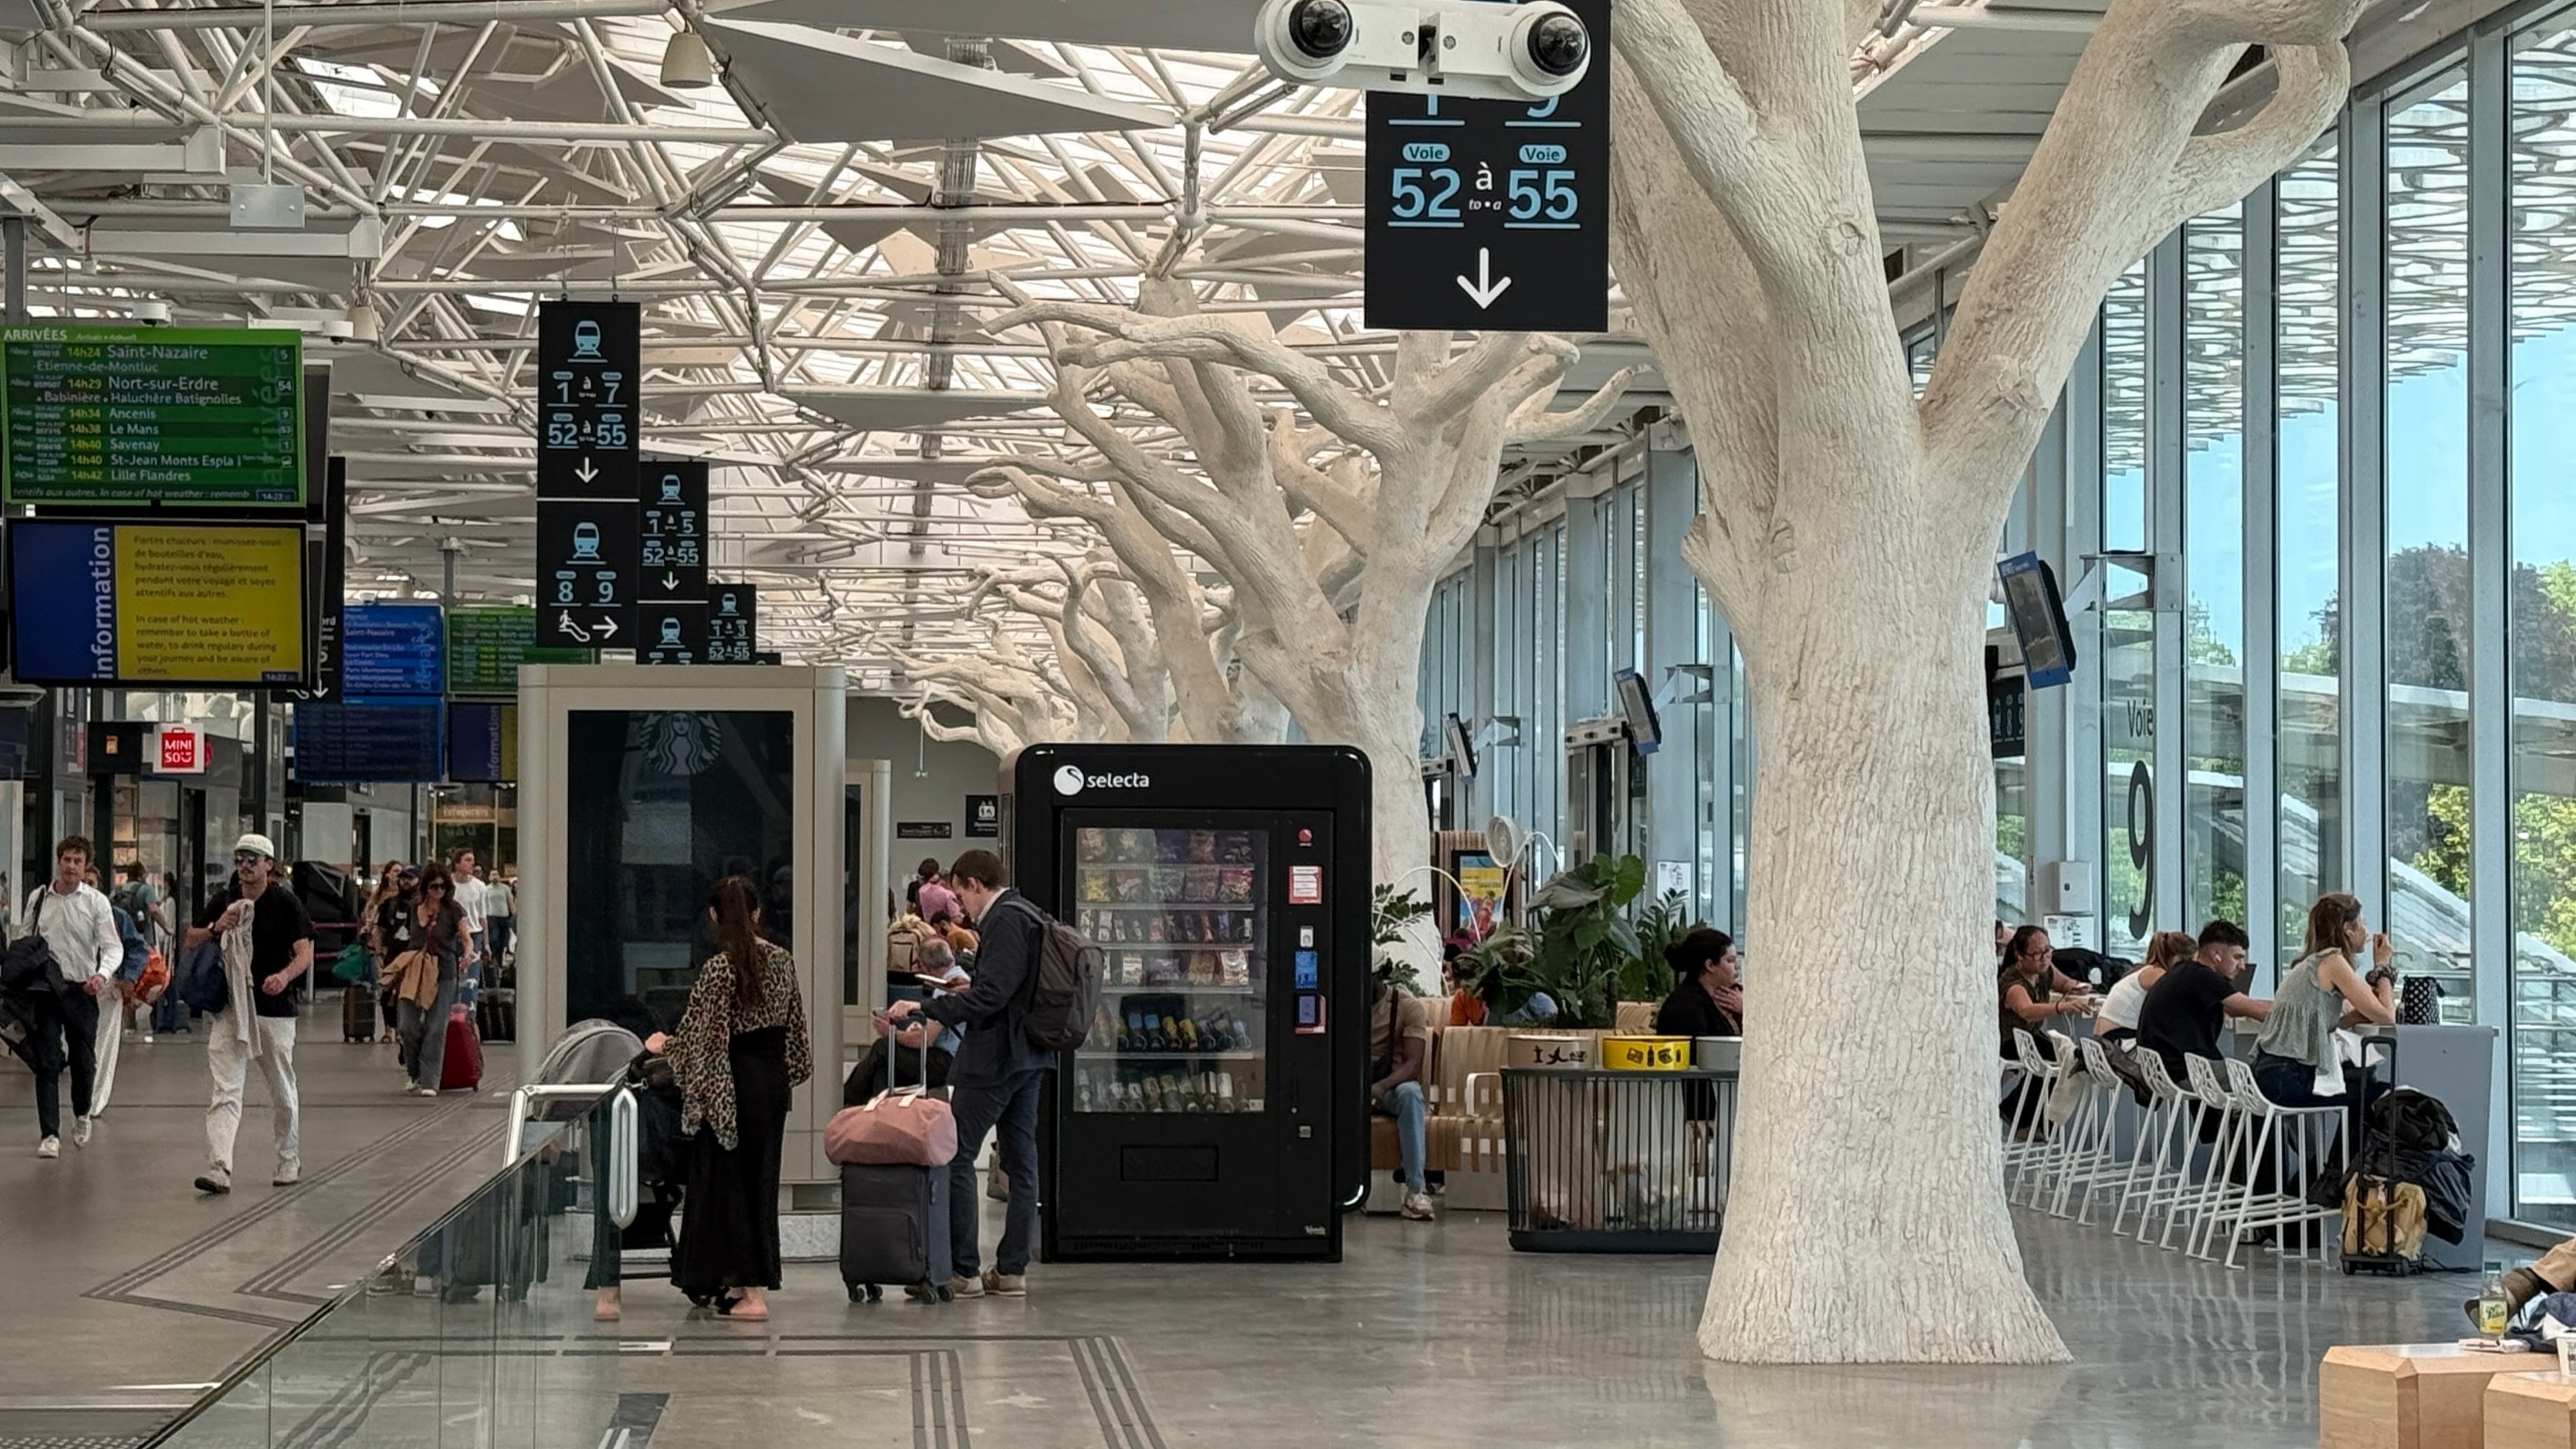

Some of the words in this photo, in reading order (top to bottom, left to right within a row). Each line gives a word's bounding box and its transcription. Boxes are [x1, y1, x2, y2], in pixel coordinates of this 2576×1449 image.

[1409, 146, 1444, 159] Voie
[1525, 148, 1561, 161] Voie
[1392, 168, 1461, 218] 52
[1476, 161, 1494, 190] à
[1509, 169, 1579, 220] 55
[1469, 199, 1482, 211] to
[4, 327, 68, 341] ARRIVÉES
[67, 347, 101, 357] 14h24
[107, 345, 208, 359] Saint-Nazaire
[67, 379, 102, 390] 14h29
[109, 376, 219, 391] Nort-sur-Erdre
[45, 390, 101, 403] Babinière
[111, 393, 172, 404] Haluchère
[175, 393, 243, 407] Batignolles
[557, 382, 568, 403] 1
[604, 382, 619, 403] 7
[69, 408, 101, 418] 14h34
[109, 407, 157, 419] Ancenis
[109, 423, 124, 434] Le
[127, 423, 159, 435] Mans
[548, 423, 578, 444] 52
[597, 424, 627, 446] 55
[71, 440, 102, 450] 14h40
[110, 439, 160, 452] Savenay
[71, 455, 102, 465] 14h40
[110, 454, 157, 467] St-Jean
[161, 455, 199, 467] Monts
[202, 456, 233, 469] Espla
[111, 470, 136, 482] Lille
[140, 470, 192, 482] Flandres
[649, 518, 658, 534] 1
[683, 519, 694, 534] 5
[643, 547, 665, 563] 52
[678, 547, 699, 564] 55
[558, 580, 574, 602] 8
[598, 581, 614, 603] 9
[88, 528, 115, 680] information
[2127, 699, 2154, 737] Voie
[165, 740, 192, 750] MINI
[1087, 773, 1150, 788] selecta
[2128, 760, 2154, 940] 9
